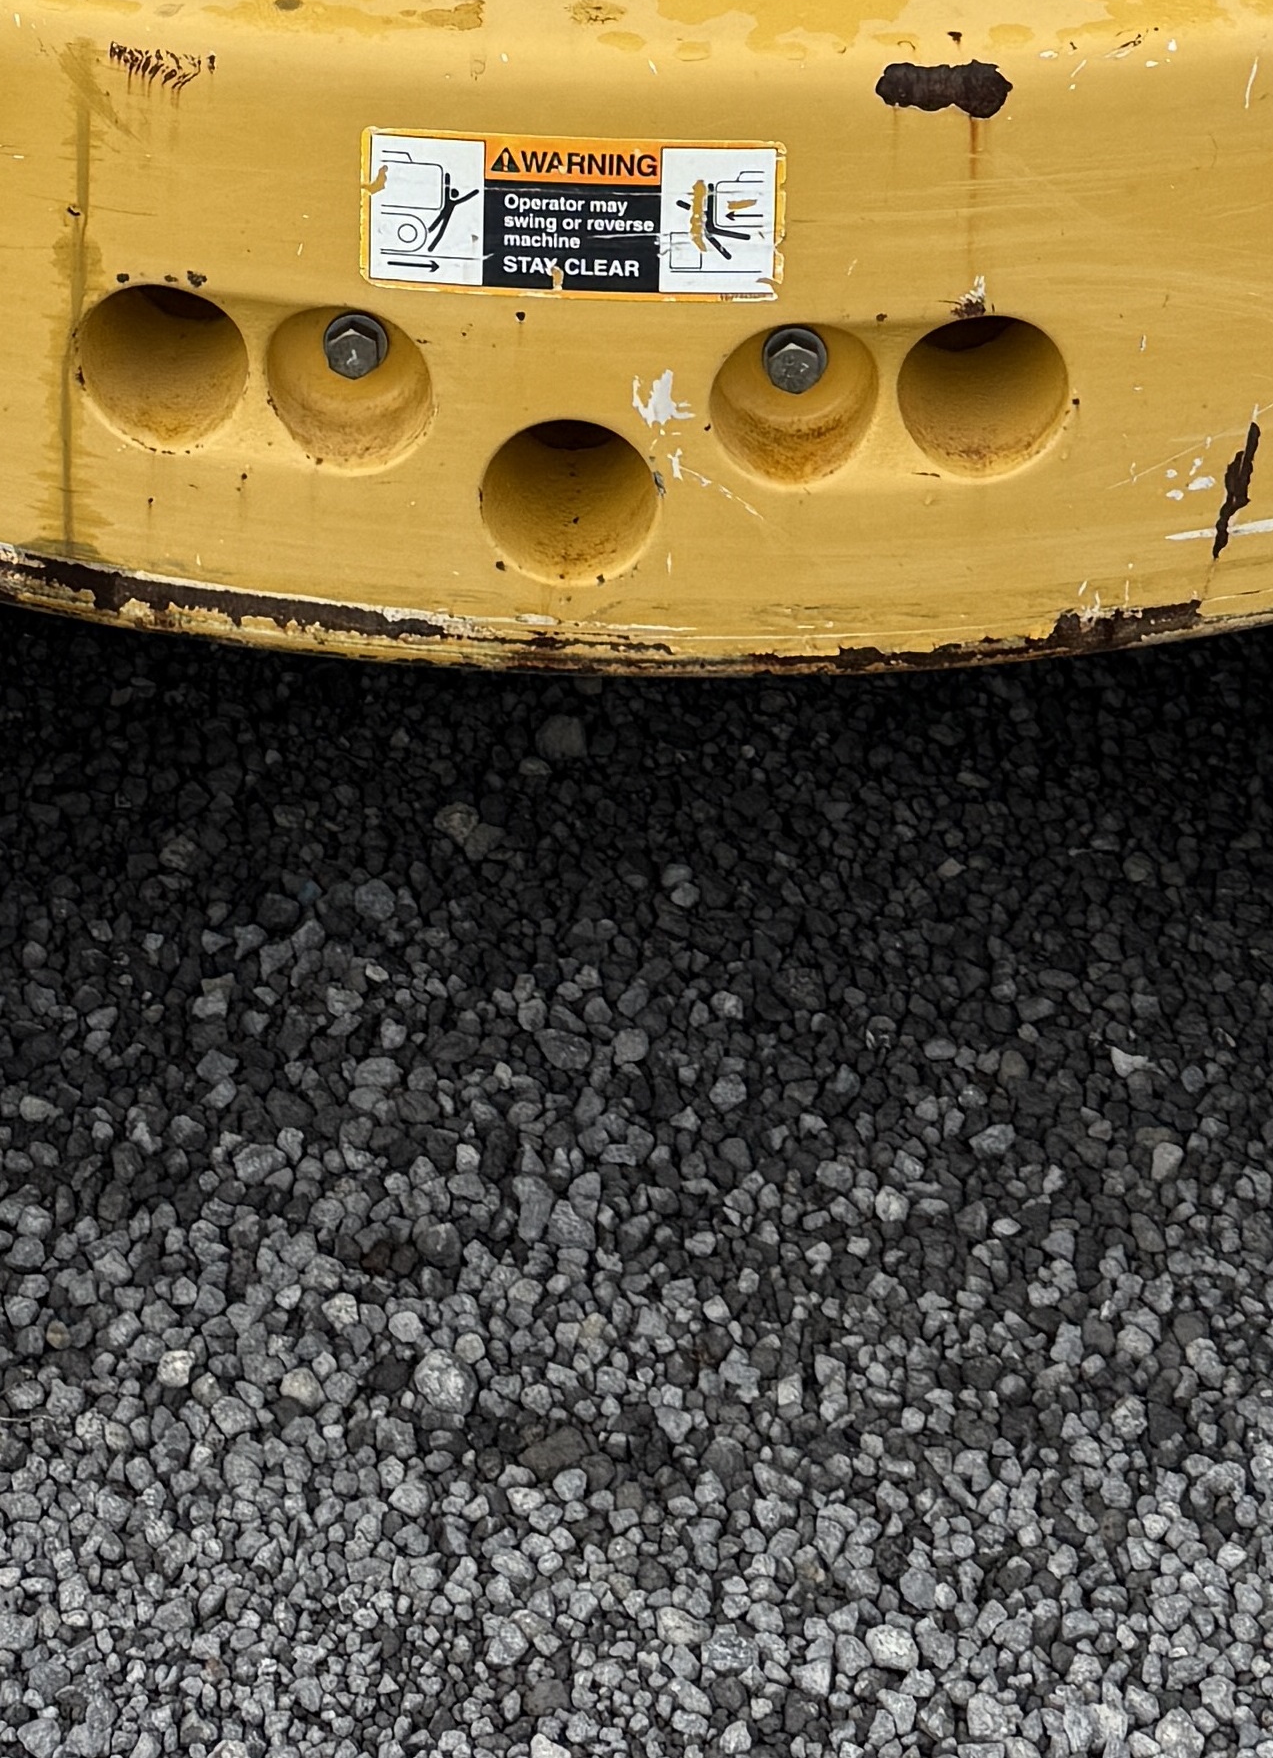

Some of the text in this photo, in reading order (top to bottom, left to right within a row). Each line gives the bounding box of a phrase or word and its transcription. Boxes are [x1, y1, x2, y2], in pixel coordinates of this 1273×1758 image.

[521, 150, 658, 177] WARNING
[503, 193, 628, 217] Operator may
[503, 213, 655, 233] swing or reverse
[503, 232, 581, 249] machine
[502, 255, 640, 278] STAY CLEAR
